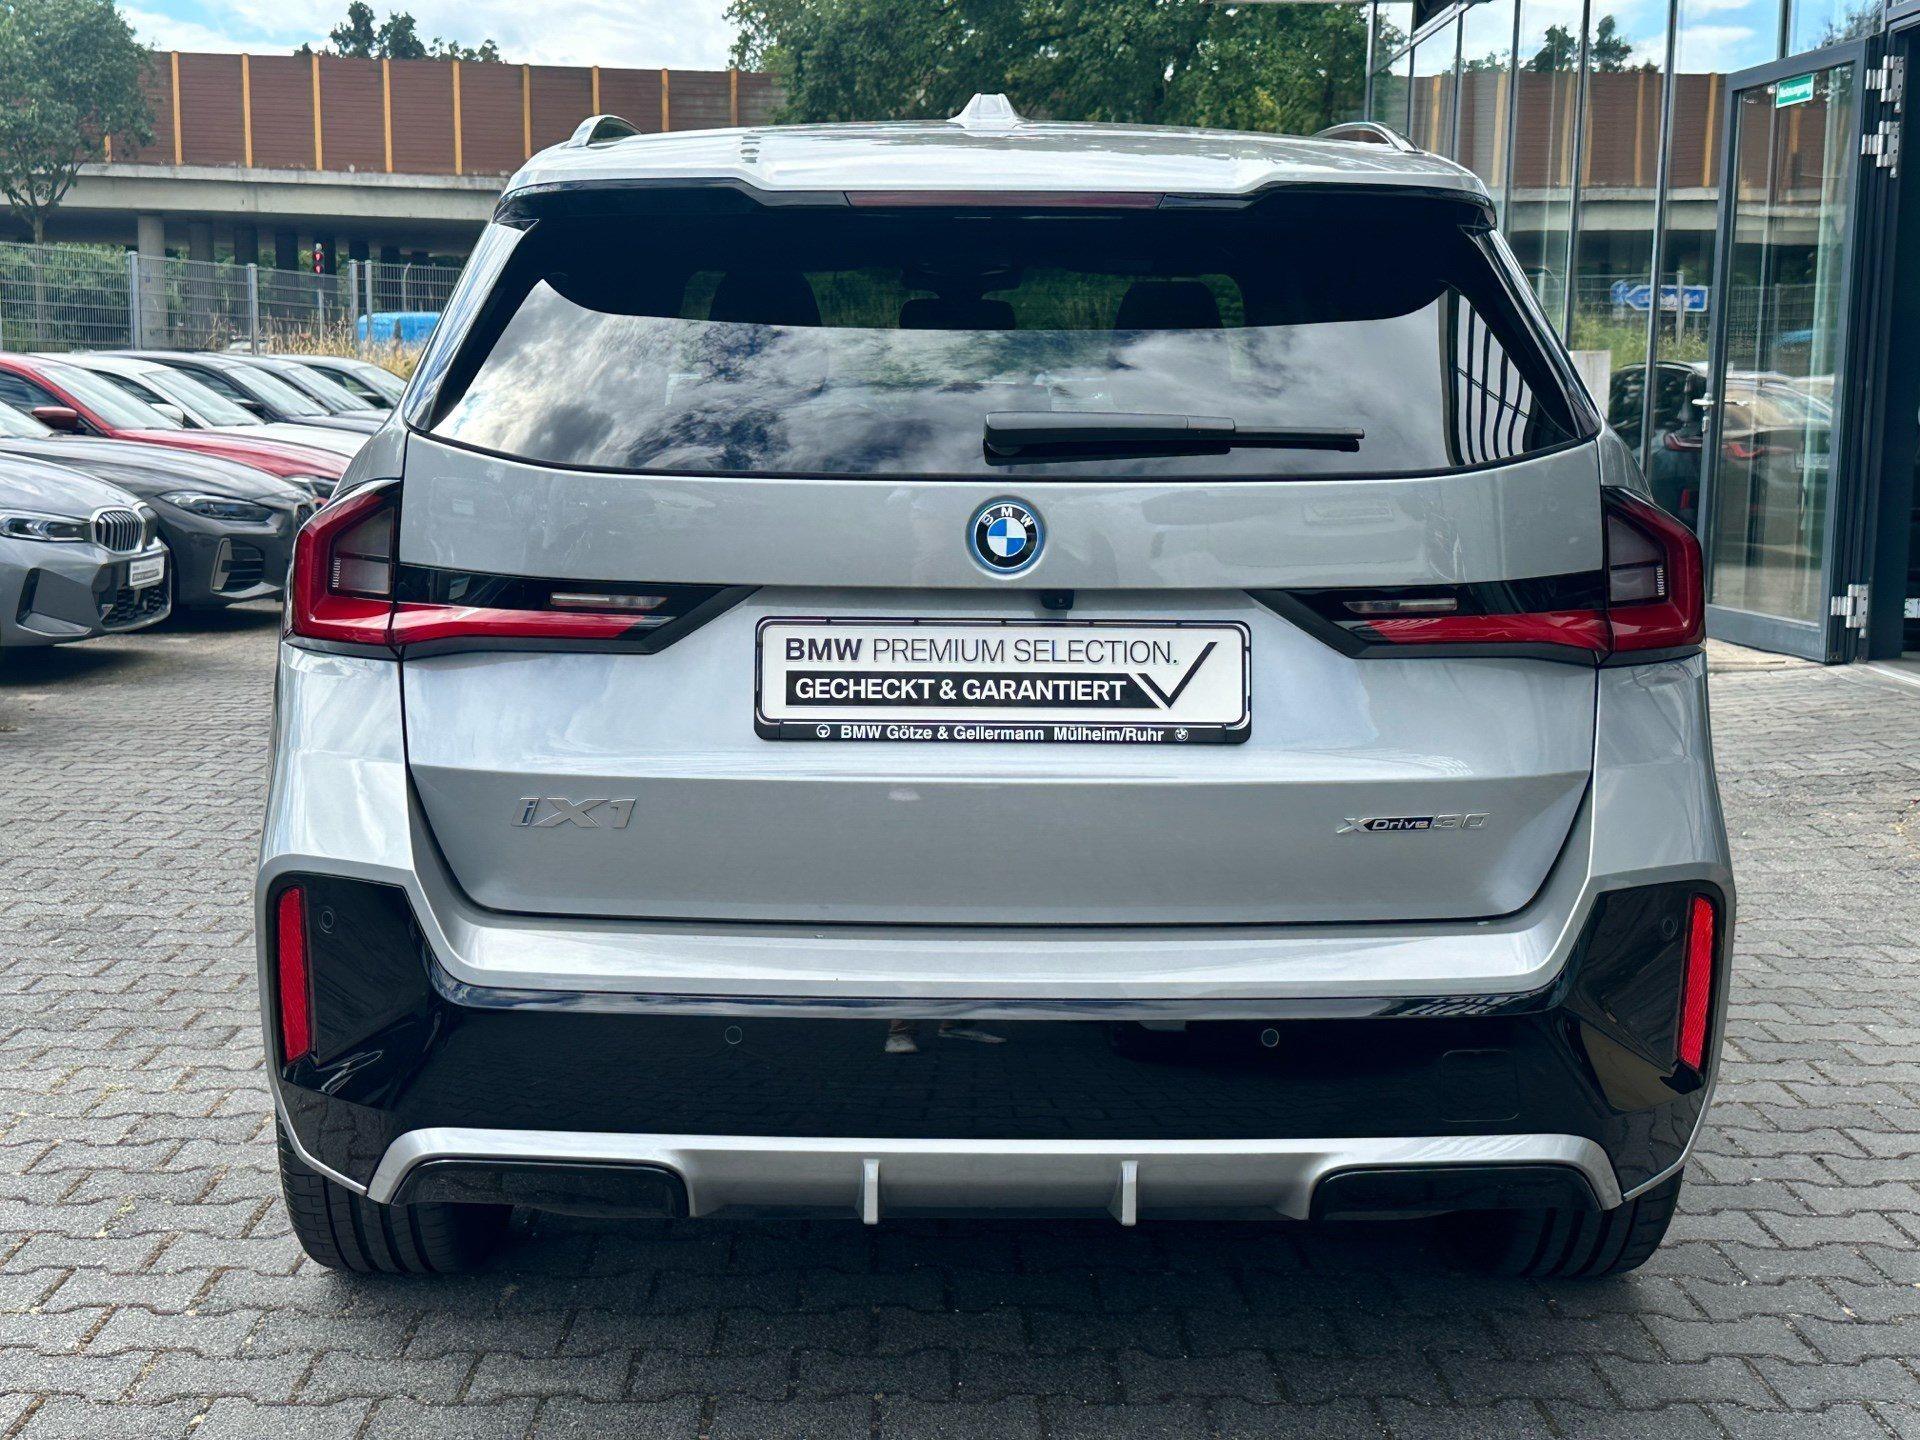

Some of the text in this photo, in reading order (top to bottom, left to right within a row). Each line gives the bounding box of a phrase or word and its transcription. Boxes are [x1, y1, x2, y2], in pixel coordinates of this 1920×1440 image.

[980, 506, 1034, 528] BMW
[785, 637, 1177, 664] BMW PREMIUM SELECTION.
[795, 677, 1127, 701] GECHECKT & GARANTIERT
[840, 724, 1165, 742] BMW Götze & Gellermann Mülheim/Ruhr
[511, 797, 637, 829] iX1
